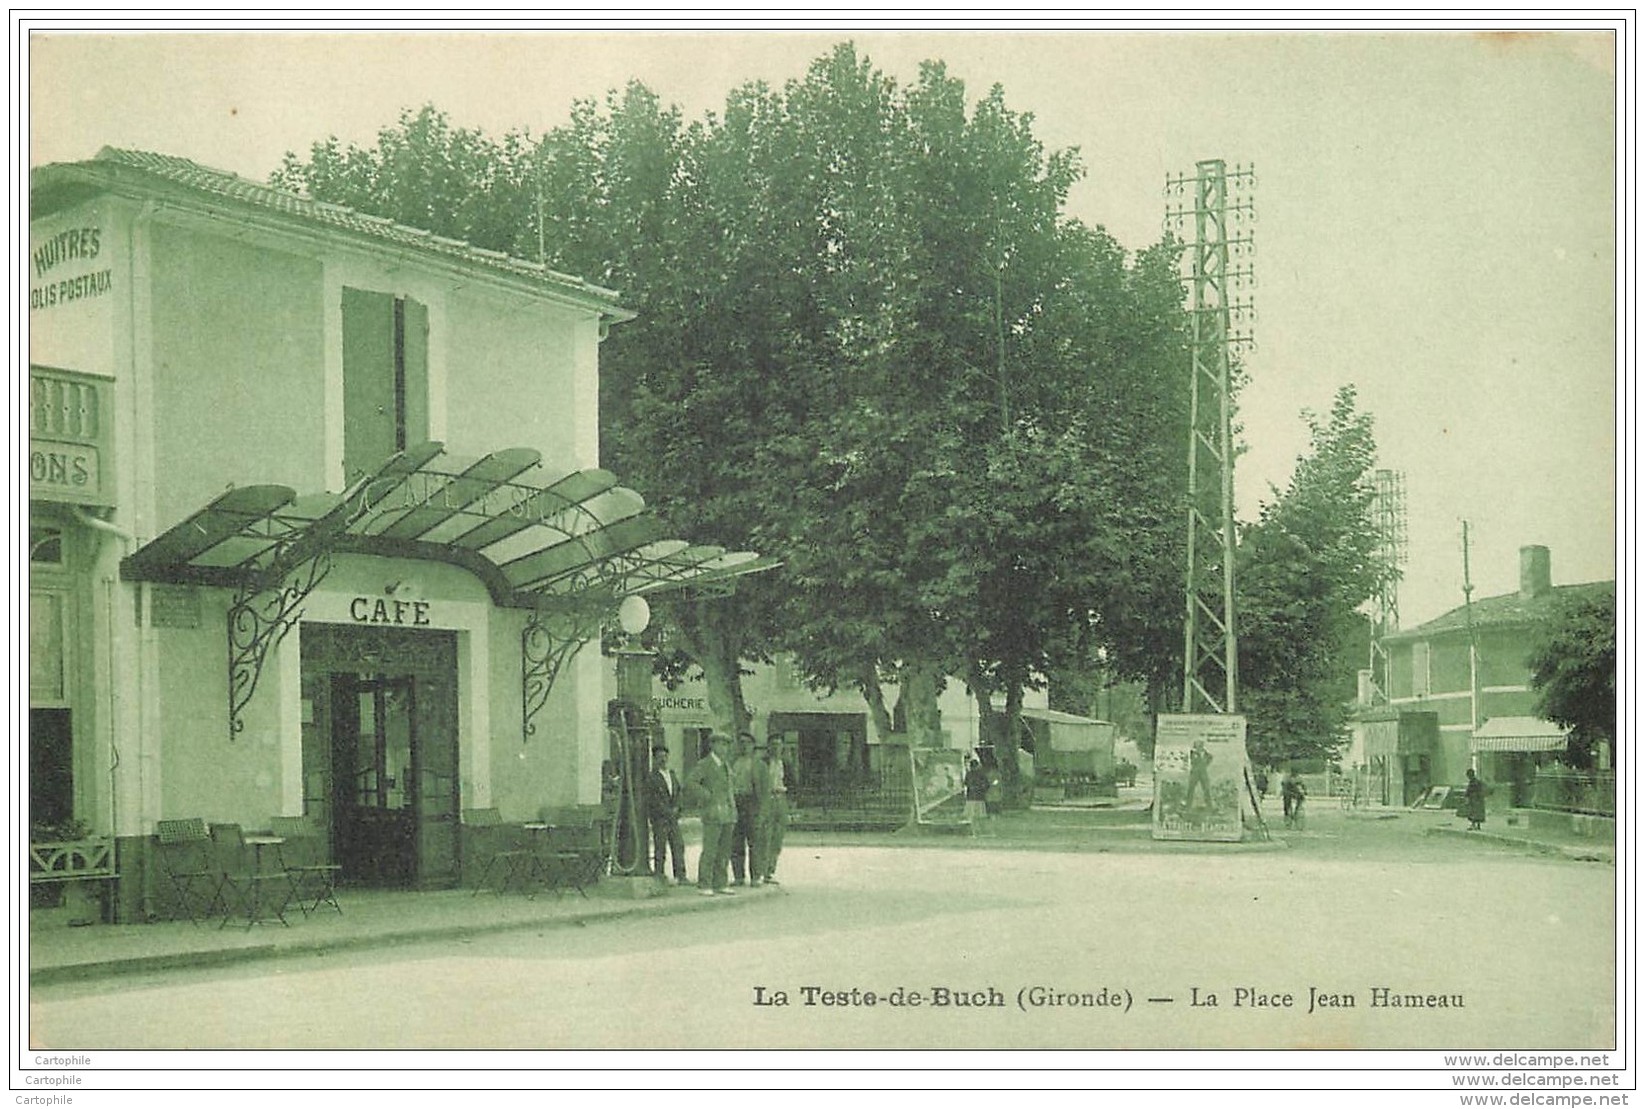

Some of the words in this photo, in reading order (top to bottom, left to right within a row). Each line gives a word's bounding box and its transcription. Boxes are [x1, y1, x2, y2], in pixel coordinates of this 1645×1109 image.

[33, 228, 101, 278] HUITRES
[60, 269, 112, 304] POSTAUX
[31, 451, 88, 486] ONS
